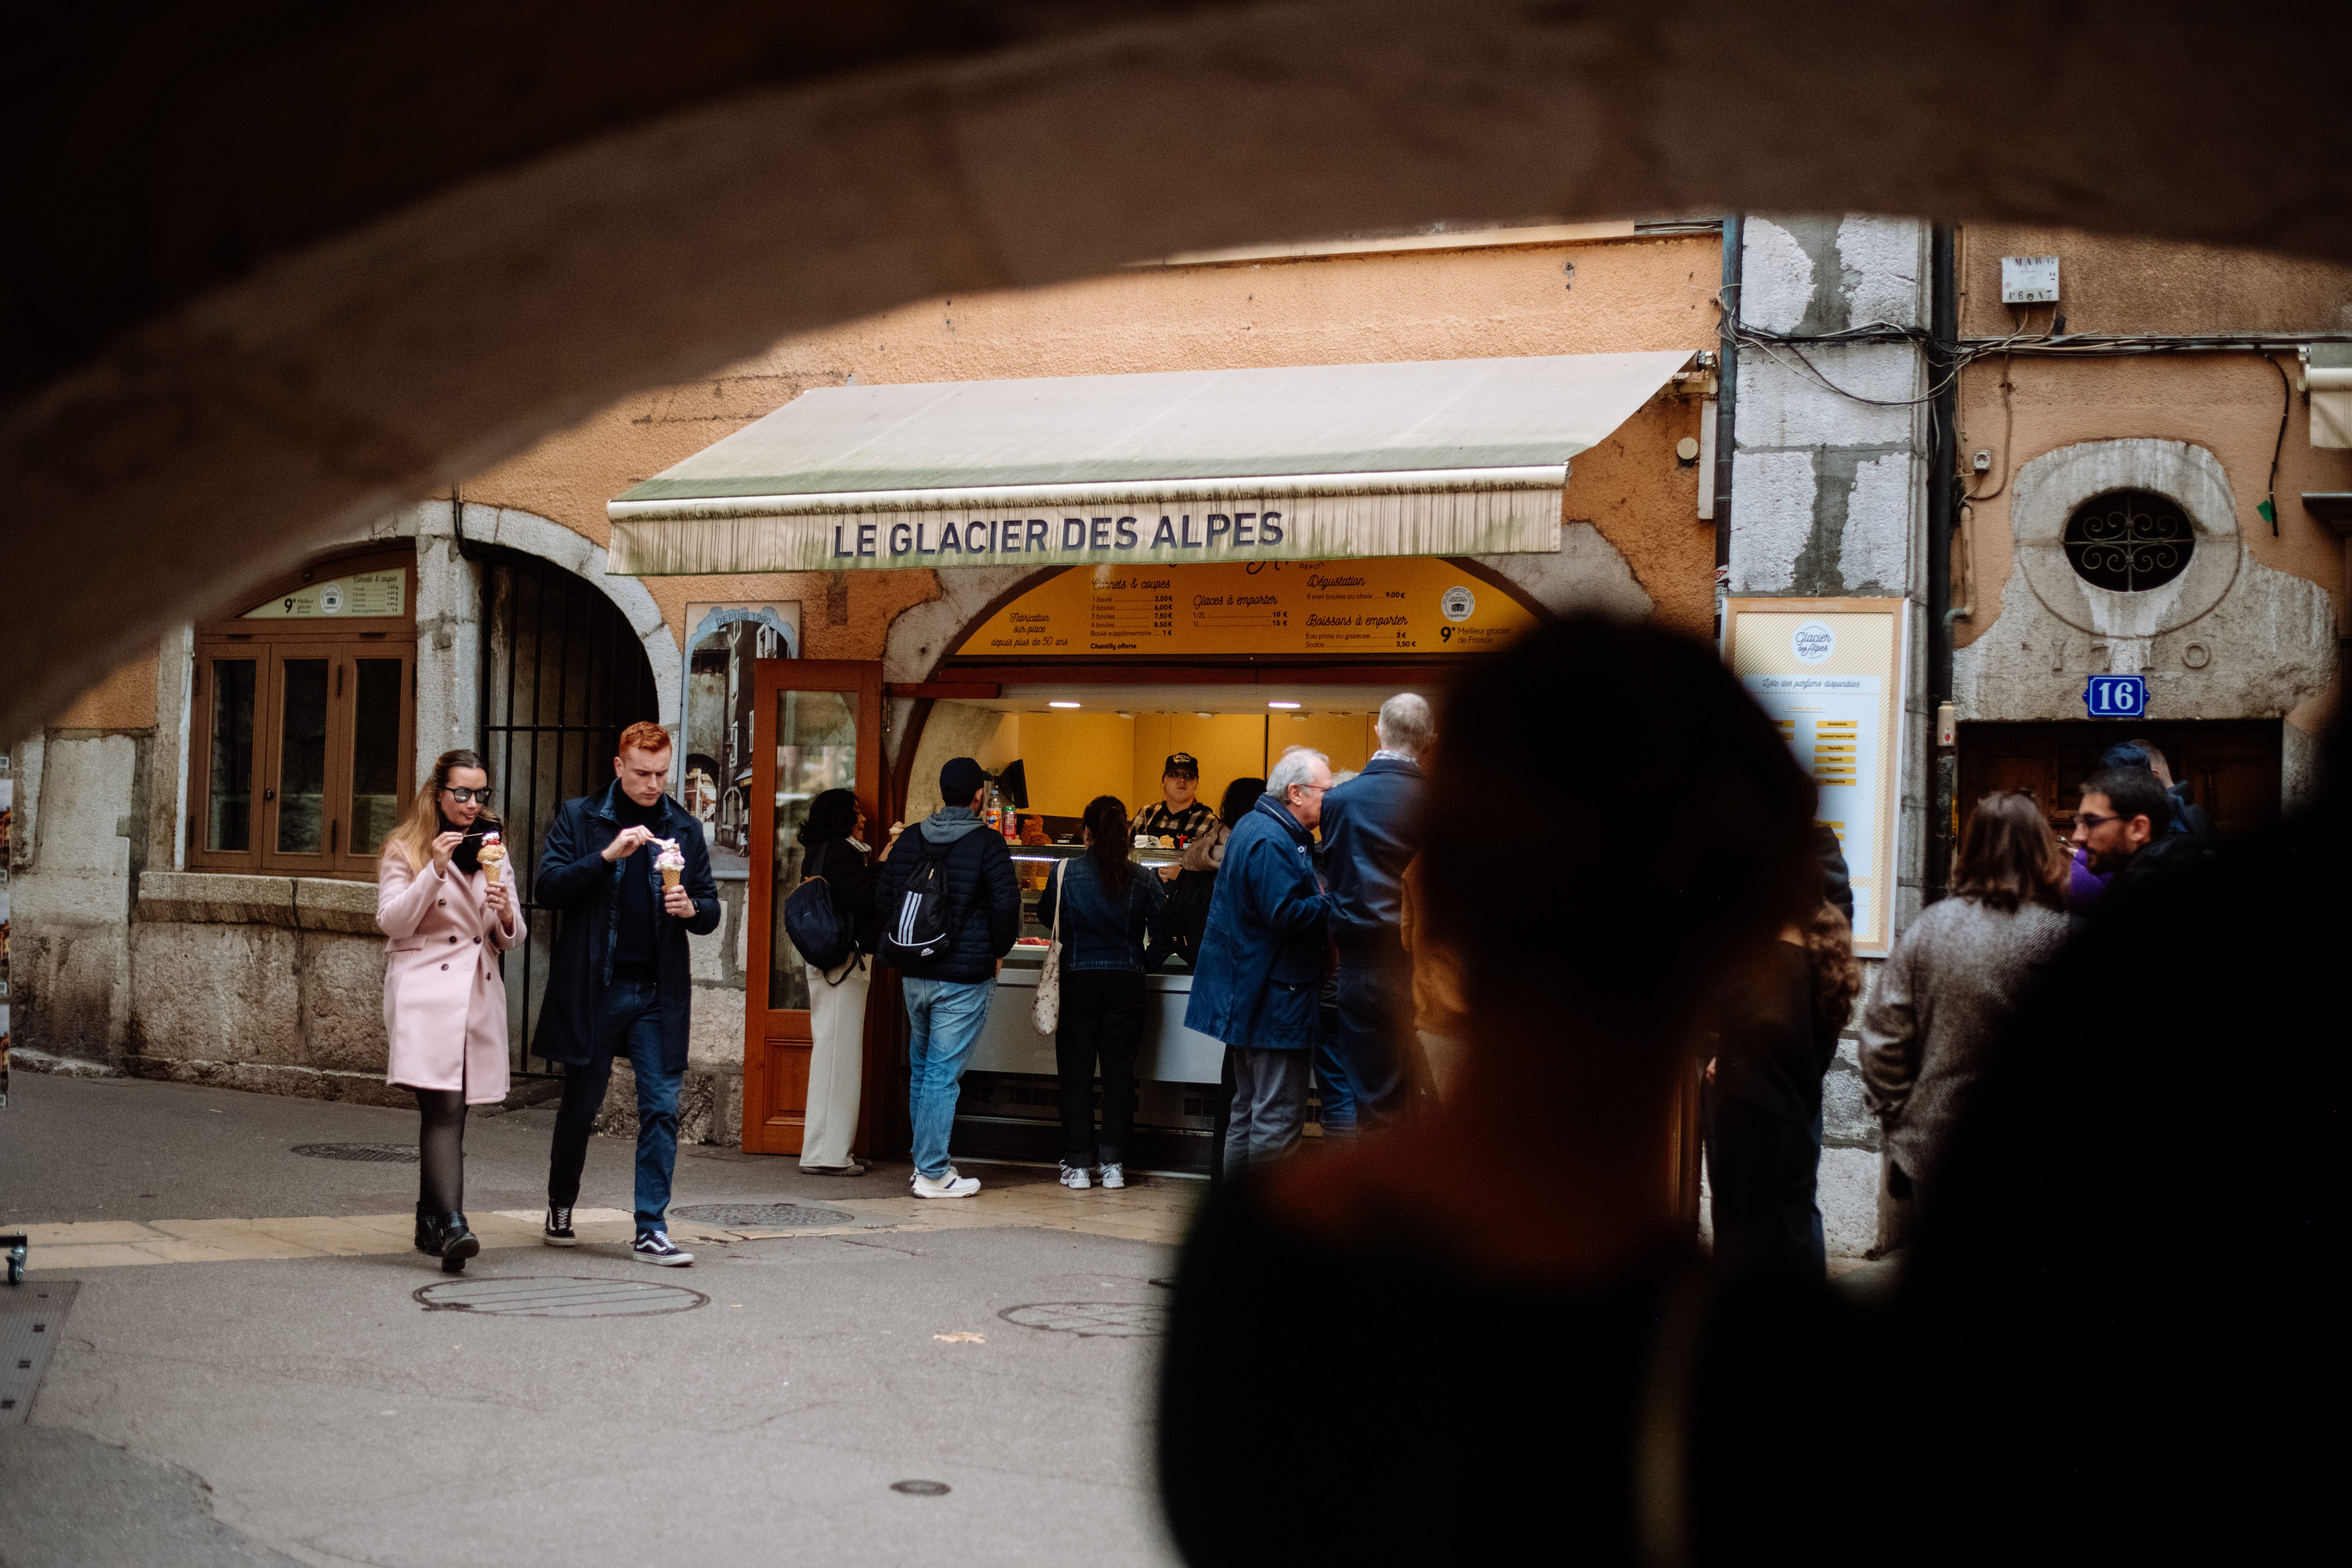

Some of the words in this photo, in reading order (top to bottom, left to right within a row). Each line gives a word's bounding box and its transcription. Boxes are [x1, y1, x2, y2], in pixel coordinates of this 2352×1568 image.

[835, 525, 877, 558] LE
[889, 519, 1048, 556] GLACIER
[1062, 517, 1138, 551] DES
[1150, 512, 1283, 550] ALPES
[1299, 561, 1325, 570] DEPUIS
[1131, 578, 1138, 588] &
[1141, 580, 1170, 592] coupes
[1307, 575, 1365, 590] Dégustation
[1193, 595, 1223, 609] Glaces
[1227, 594, 1234, 605] à
[1236, 594, 1277, 608] emporter
[716, 612, 749, 626] DEPUIS
[752, 612, 771, 625] 1960
[1010, 613, 1050, 623] Fabrication
[1306, 614, 1351, 627] Boissons
[1355, 615, 1363, 625] à
[1366, 615, 1408, 629] emporter
[1027, 625, 1046, 635] place
[1486, 627, 1510, 635] glacier
[991, 638, 1012, 648] depuis
[1014, 638, 1029, 648] plus
[1042, 637, 1053, 646] 50
[1796, 632, 1831, 646] Glacier
[1801, 643, 1827, 656] Alpes
[1762, 678, 1779, 688] Liste
[1793, 679, 1821, 689] parfums
[1824, 680, 1860, 689] disponibles
[2099, 682, 2134, 710] 16
